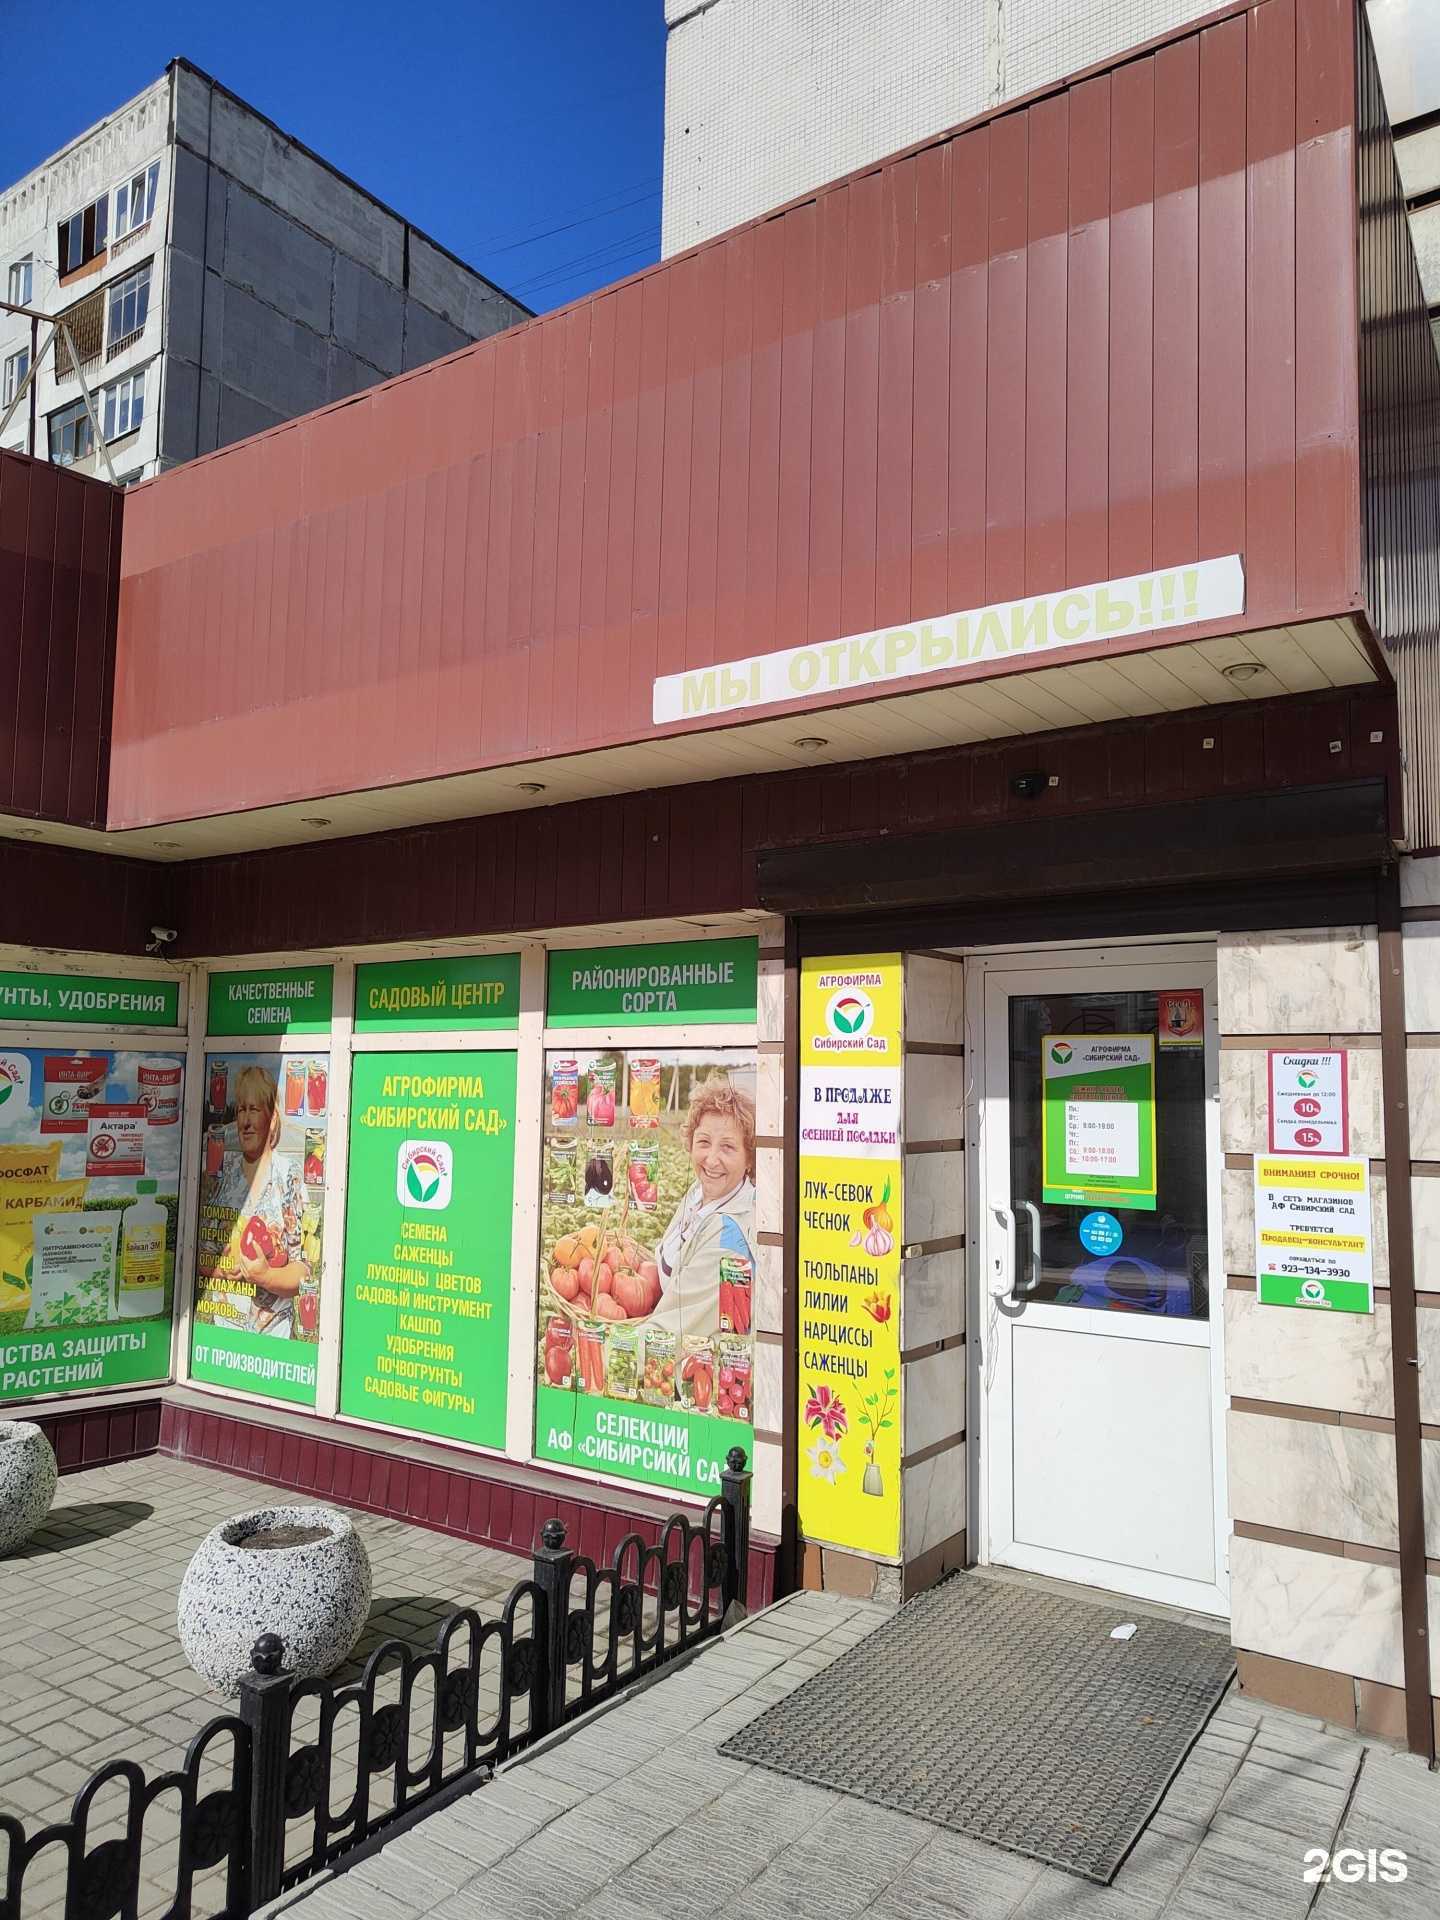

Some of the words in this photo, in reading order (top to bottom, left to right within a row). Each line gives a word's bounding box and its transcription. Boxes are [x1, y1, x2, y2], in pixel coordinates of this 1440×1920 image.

[682, 663, 761, 714] МЫ
[788, 570, 1200, 692] ОТКРЫЛИСЬ!!!
[572, 961, 734, 991] РАЙОНИРОВАННЫЕ
[819, 974, 882, 987] АГРОФИРМА
[58, 990, 165, 1012] УДОБРЕНИЯ
[228, 981, 315, 1001] КАЧЕСТВЕННЫЕ
[369, 979, 446, 1012] САДОВЫЙ
[451, 982, 505, 1010] ЦЕНТР
[622, 991, 678, 1014] СОРТА
[247, 1006, 292, 1025] СЕМЕНА
[814, 1036, 864, 1051] Сибирский
[866, 1037, 886, 1051] Сад
[1091, 1045, 1131, 1053] АГРОФИРМА
[1283, 1056, 1319, 1068] Скидки
[1321, 1056, 1332, 1066] !!!
[382, 1075, 484, 1099] АГРОФИРМА
[814, 1087, 822, 1102] В
[825, 1087, 892, 1104] ПРОДАЖЕ
[100, 1121, 136, 1131] Актара
[360, 1102, 461, 1131] «СИБИРСКИЙ
[464, 1108, 507, 1136] САД»
[837, 1112, 859, 1125] ДЛЯ
[802, 1127, 844, 1142] ОСЕННЕЙ
[846, 1130, 896, 1145] ПОСАДКИ
[402, 1146, 436, 1170] Сибирский
[1263, 1168, 1316, 1179] ВНИМАНИЕ!
[1319, 1171, 1360, 1181] СРОЧНО!
[5, 1196, 83, 1210] КАРБАМИД
[803, 1180, 874, 1203] ЛУК-СЕВОК
[1268, 1193, 1275, 1201] В
[203, 1206, 239, 1220] ТОМАТЫ
[803, 1210, 850, 1232] ЧЕСНОК
[201, 1227, 232, 1243] ПЕРЦЫ
[401, 1221, 448, 1243] СЕМЕНА
[199, 1253, 234, 1271] ОГУРЦЫ
[393, 1243, 453, 1269] САЖЕНЦЫ
[366, 1263, 429, 1288] ЛУКОВИЦЫ
[435, 1272, 482, 1294] ЦВЕТОВ
[803, 1260, 879, 1286] ТЮЛЬПАНЫ
[1281, 1263, 1351, 1278] 923-134-3930
[198, 1276, 257, 1297] БАКЛАЖАНЫ
[356, 1284, 410, 1308] САДОВЫЙ
[413, 1292, 492, 1320] ИНСТРУМЕНТ
[803, 1290, 849, 1314] ЛИЛИИ
[400, 1313, 442, 1336] КАШПО
[803, 1320, 873, 1348] НАРЦИССЫ
[62, 1332, 147, 1358] ЗАЩИТЫ
[386, 1334, 454, 1362] УДОБРЕНИЯ
[2, 1357, 104, 1391] РАСТЕНИЙ
[195, 1344, 209, 1364] ОТ
[211, 1348, 315, 1386] ПРОИЗВОДИТЕЛЕЙ
[377, 1355, 463, 1388] ПОЧВОГРУНТЫ
[803, 1351, 868, 1380] САЖЕНЦЫ
[364, 1376, 419, 1403] САДОВЫЕ
[422, 1388, 475, 1415] ФИГУРЫ
[595, 1411, 689, 1451] СЕЛЕКЦИИ
[547, 1427, 573, 1450] АФ
[696, 1458, 728, 1485] СА
